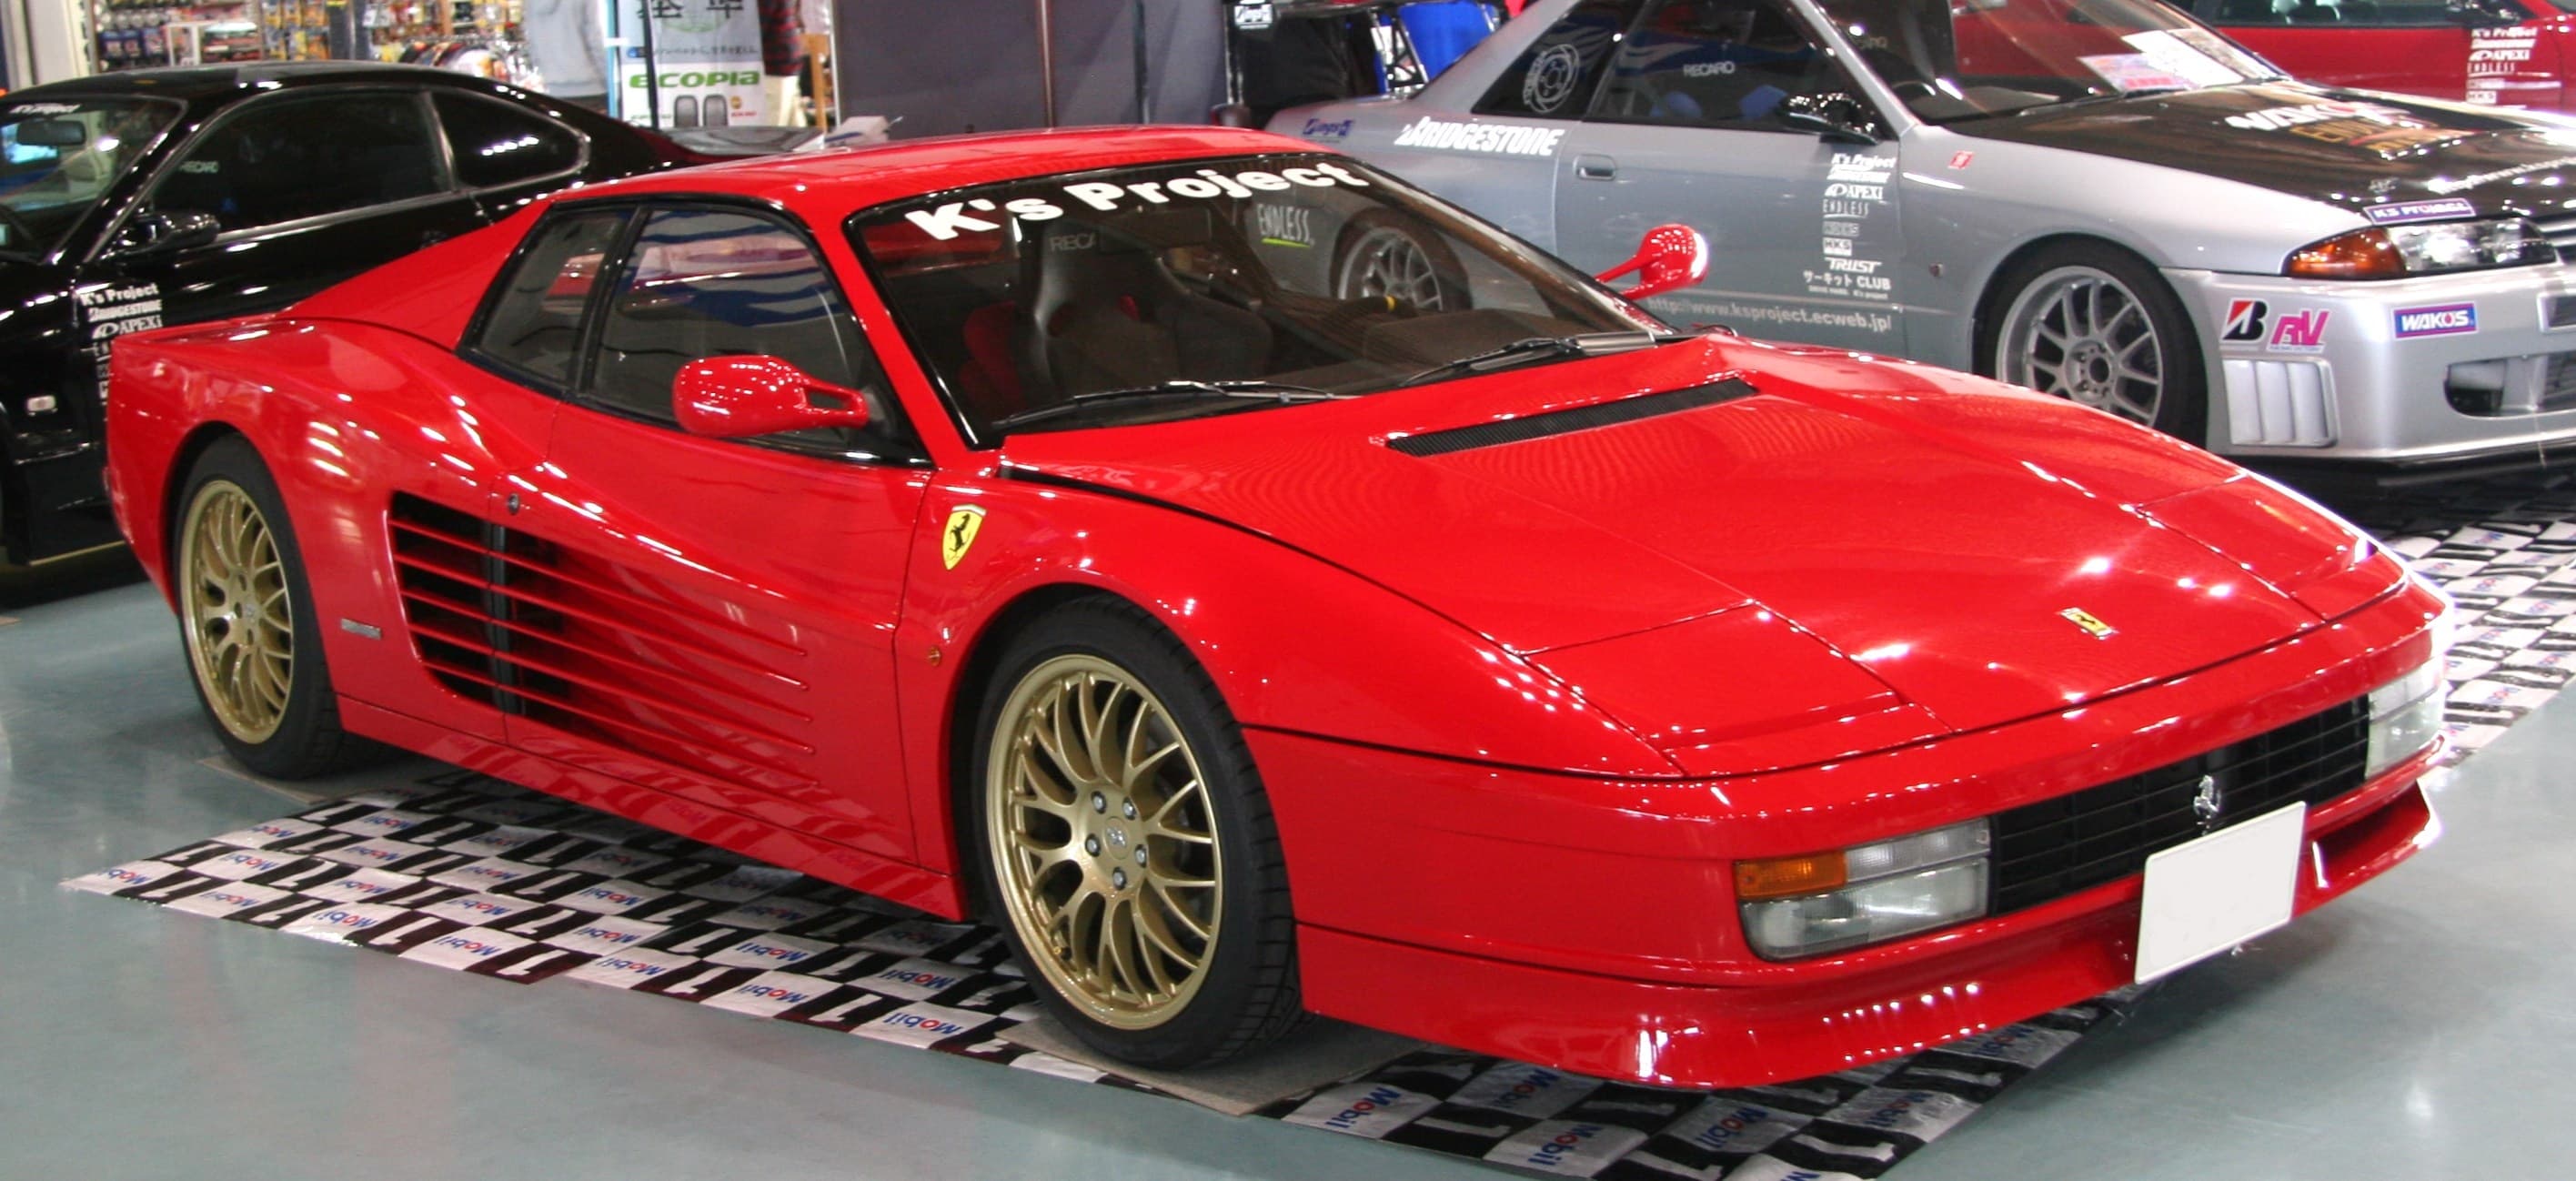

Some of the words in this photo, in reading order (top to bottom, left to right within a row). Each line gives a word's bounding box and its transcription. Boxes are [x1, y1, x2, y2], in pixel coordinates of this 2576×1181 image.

[1683, 61, 1735, 77] RECARO
[1394, 116, 1565, 156] BRIDGESTONE
[906, 197, 1064, 241] K's
[1063, 162, 1370, 212] Project
[1823, 199, 1869, 216] ENDLESS
[1256, 203, 1310, 243] ENDLESS
[1824, 239, 1851, 250] HKS
[1824, 257, 1883, 274] TRUST
[105, 282, 159, 302] Project
[1857, 276, 1892, 290] CLUB
[446, 898, 511, 915] Mobil
[579, 887, 643, 906] Mobil
[314, 910, 377, 929] Mobil
[433, 935, 502, 955] Mobil
[575, 926, 641, 944] Mobil
[736, 942, 808, 962] Mobil
[595, 957, 668, 976] Mobil
[880, 969, 956, 989] Mobil
[736, 984, 809, 1004] Mobil
[882, 1013, 963, 1035] Mobil
[1325, 1086, 1402, 1129] Mobil
[1695, 1106, 1770, 1148] Mobil
[1527, 1124, 1604, 1166] Mobil
